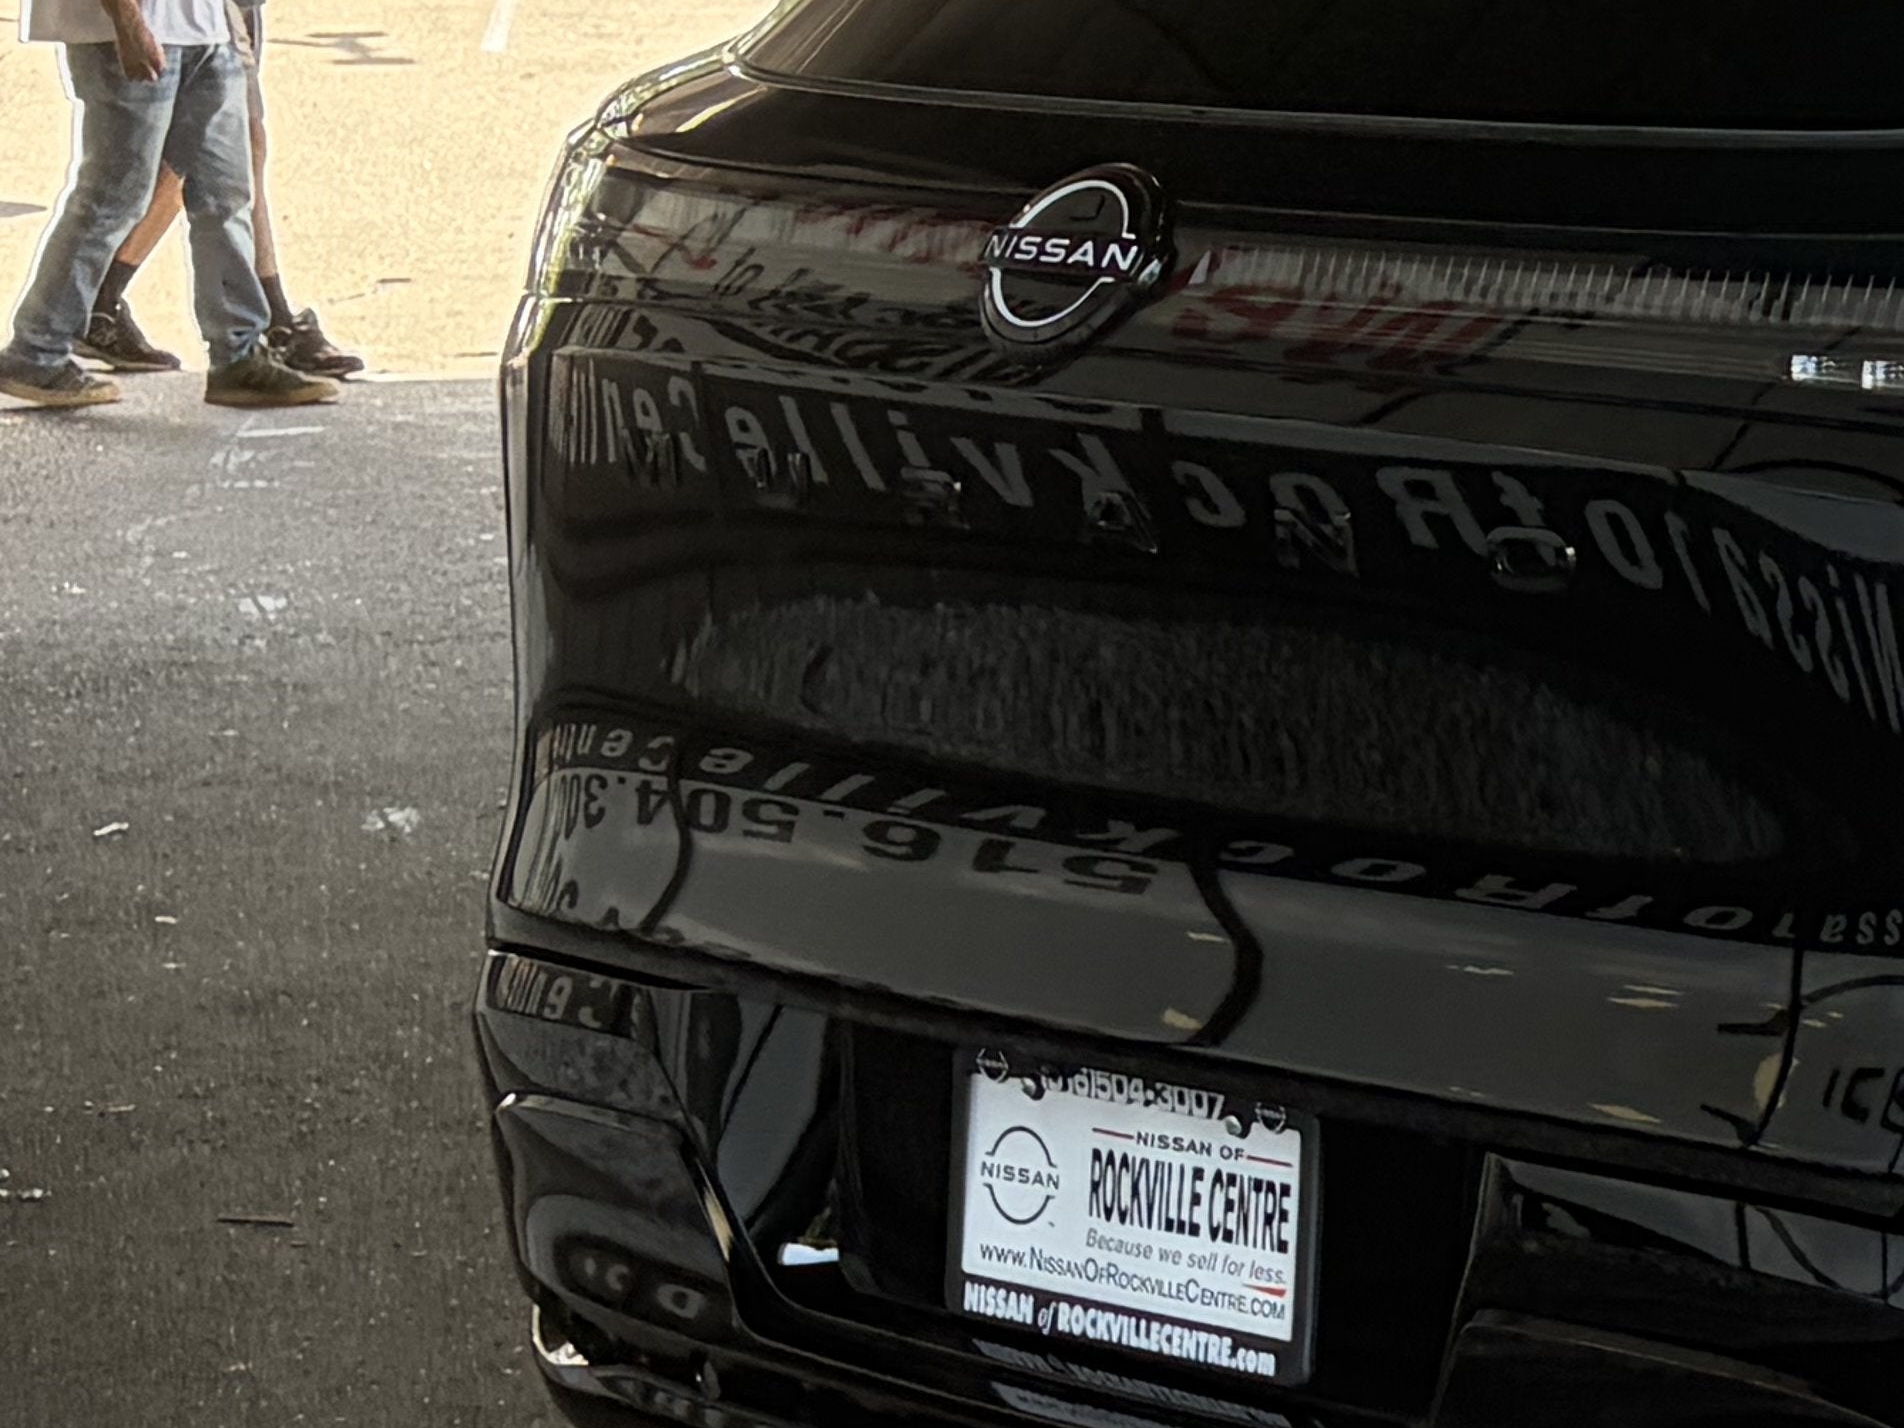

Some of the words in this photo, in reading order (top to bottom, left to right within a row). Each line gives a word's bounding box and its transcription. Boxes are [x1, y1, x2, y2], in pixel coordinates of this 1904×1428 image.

[984, 234, 1138, 271] NISSAN
[1135, 1131, 1212, 1158] NISSAN
[1219, 1144, 1246, 1162] OF
[980, 1160, 1060, 1190] NISSAN
[1088, 1146, 1205, 1238] ROCKVILLE
[1208, 1167, 1292, 1254] CENTRE
[1086, 1228, 1153, 1260] Because
[1158, 1247, 1183, 1268] we
[1187, 1248, 1218, 1271] sell
[1221, 1253, 1246, 1279] for
[1248, 1261, 1288, 1285] less.
[963, 1280, 1034, 1327] NISSAN
[1037, 1301, 1057, 1336] of
[1056, 1300, 1277, 1378] ROCKVILLECENTRE.com
